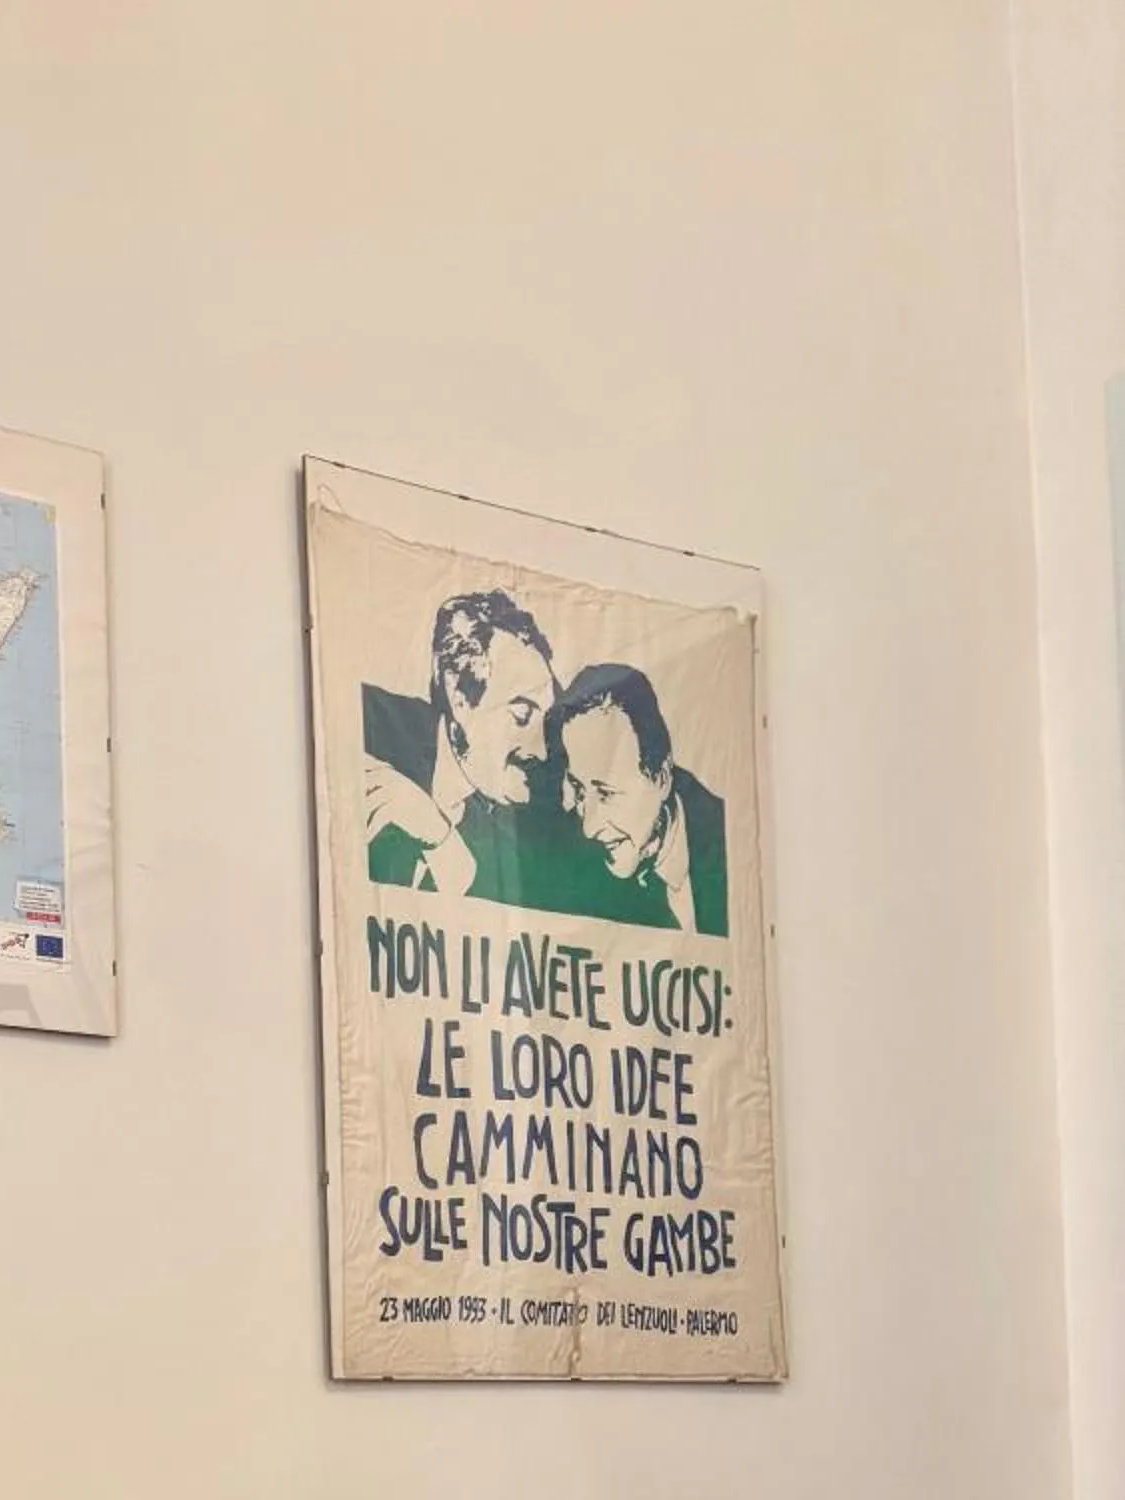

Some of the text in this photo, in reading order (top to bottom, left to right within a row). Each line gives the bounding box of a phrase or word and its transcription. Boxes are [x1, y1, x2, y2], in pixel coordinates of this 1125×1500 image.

[366, 915, 734, 1037] NON LI AVETE UCCISI:
[416, 1017, 698, 1126] LE LORO IDEE
[412, 1109, 704, 1201] CAMMINANO
[378, 1185, 737, 1278] SULLE NOSTRE GAMBE
[379, 1296, 399, 1323] 23
[402, 1295, 452, 1323] MAGGIO
[499, 1297, 516, 1325] IL
[520, 1299, 589, 1327] COMITATO
[596, 1301, 616, 1327] DEI
[620, 1302, 678, 1335] LENZUOLI
[686, 1308, 738, 1337] PALERMO
